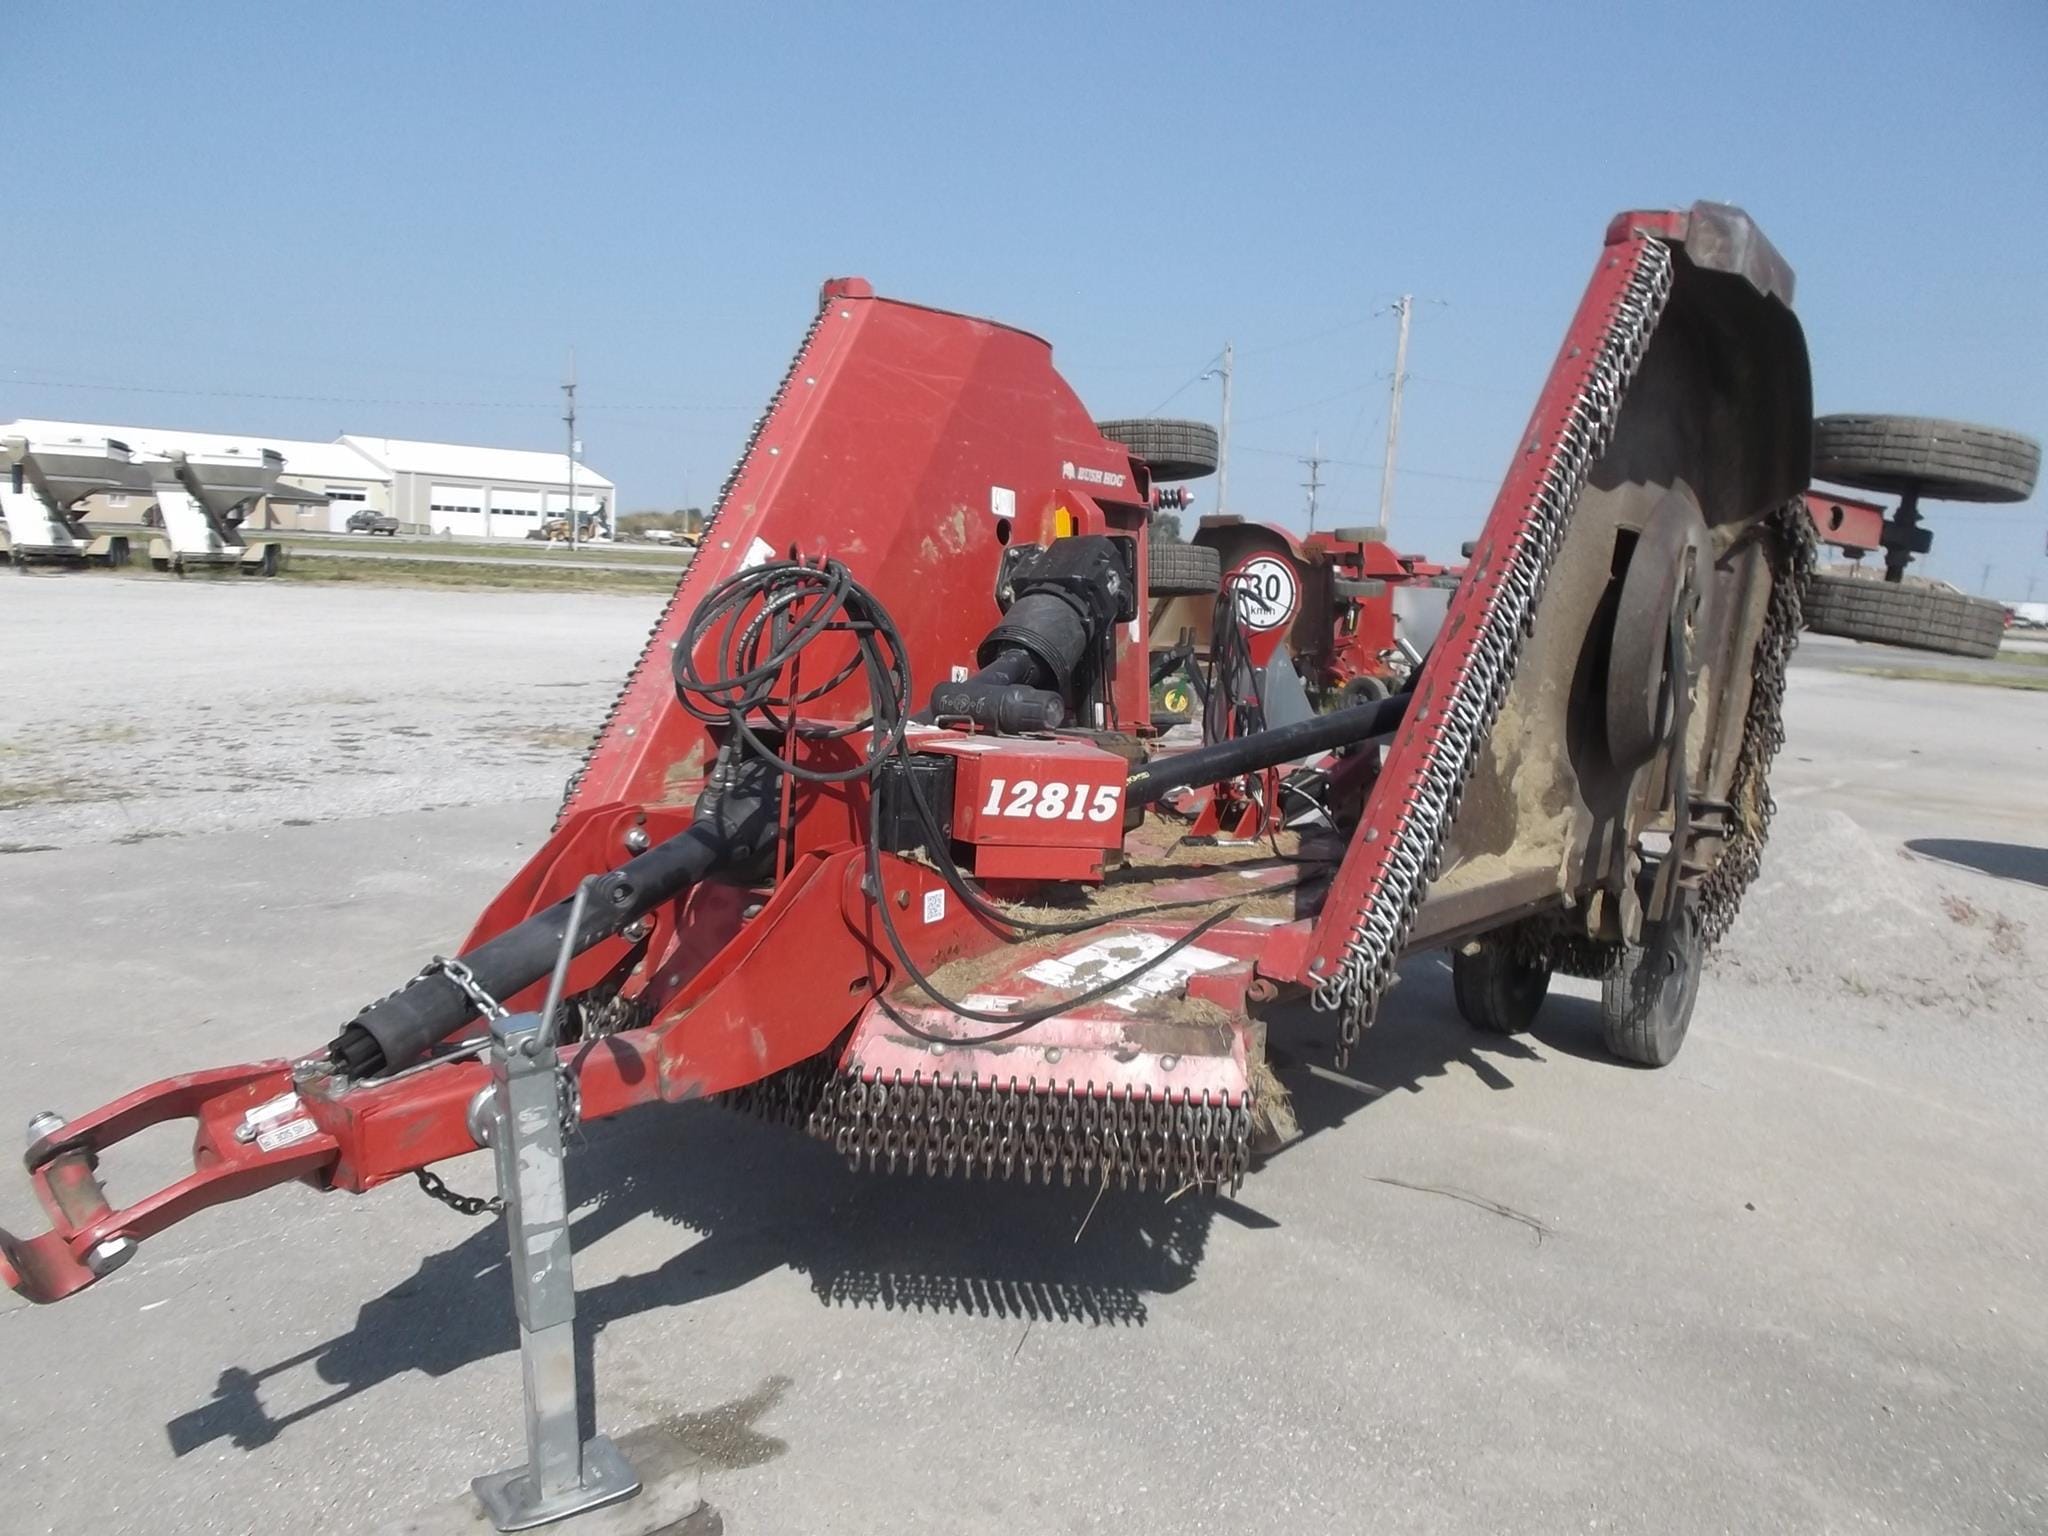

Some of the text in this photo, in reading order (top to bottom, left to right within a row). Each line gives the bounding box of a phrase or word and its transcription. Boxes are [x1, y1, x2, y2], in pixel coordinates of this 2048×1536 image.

[1103, 471, 1124, 488] HOG
[1250, 573, 1281, 602] 30
[1250, 605, 1276, 615] kmh
[981, 778, 1121, 822] 12815
